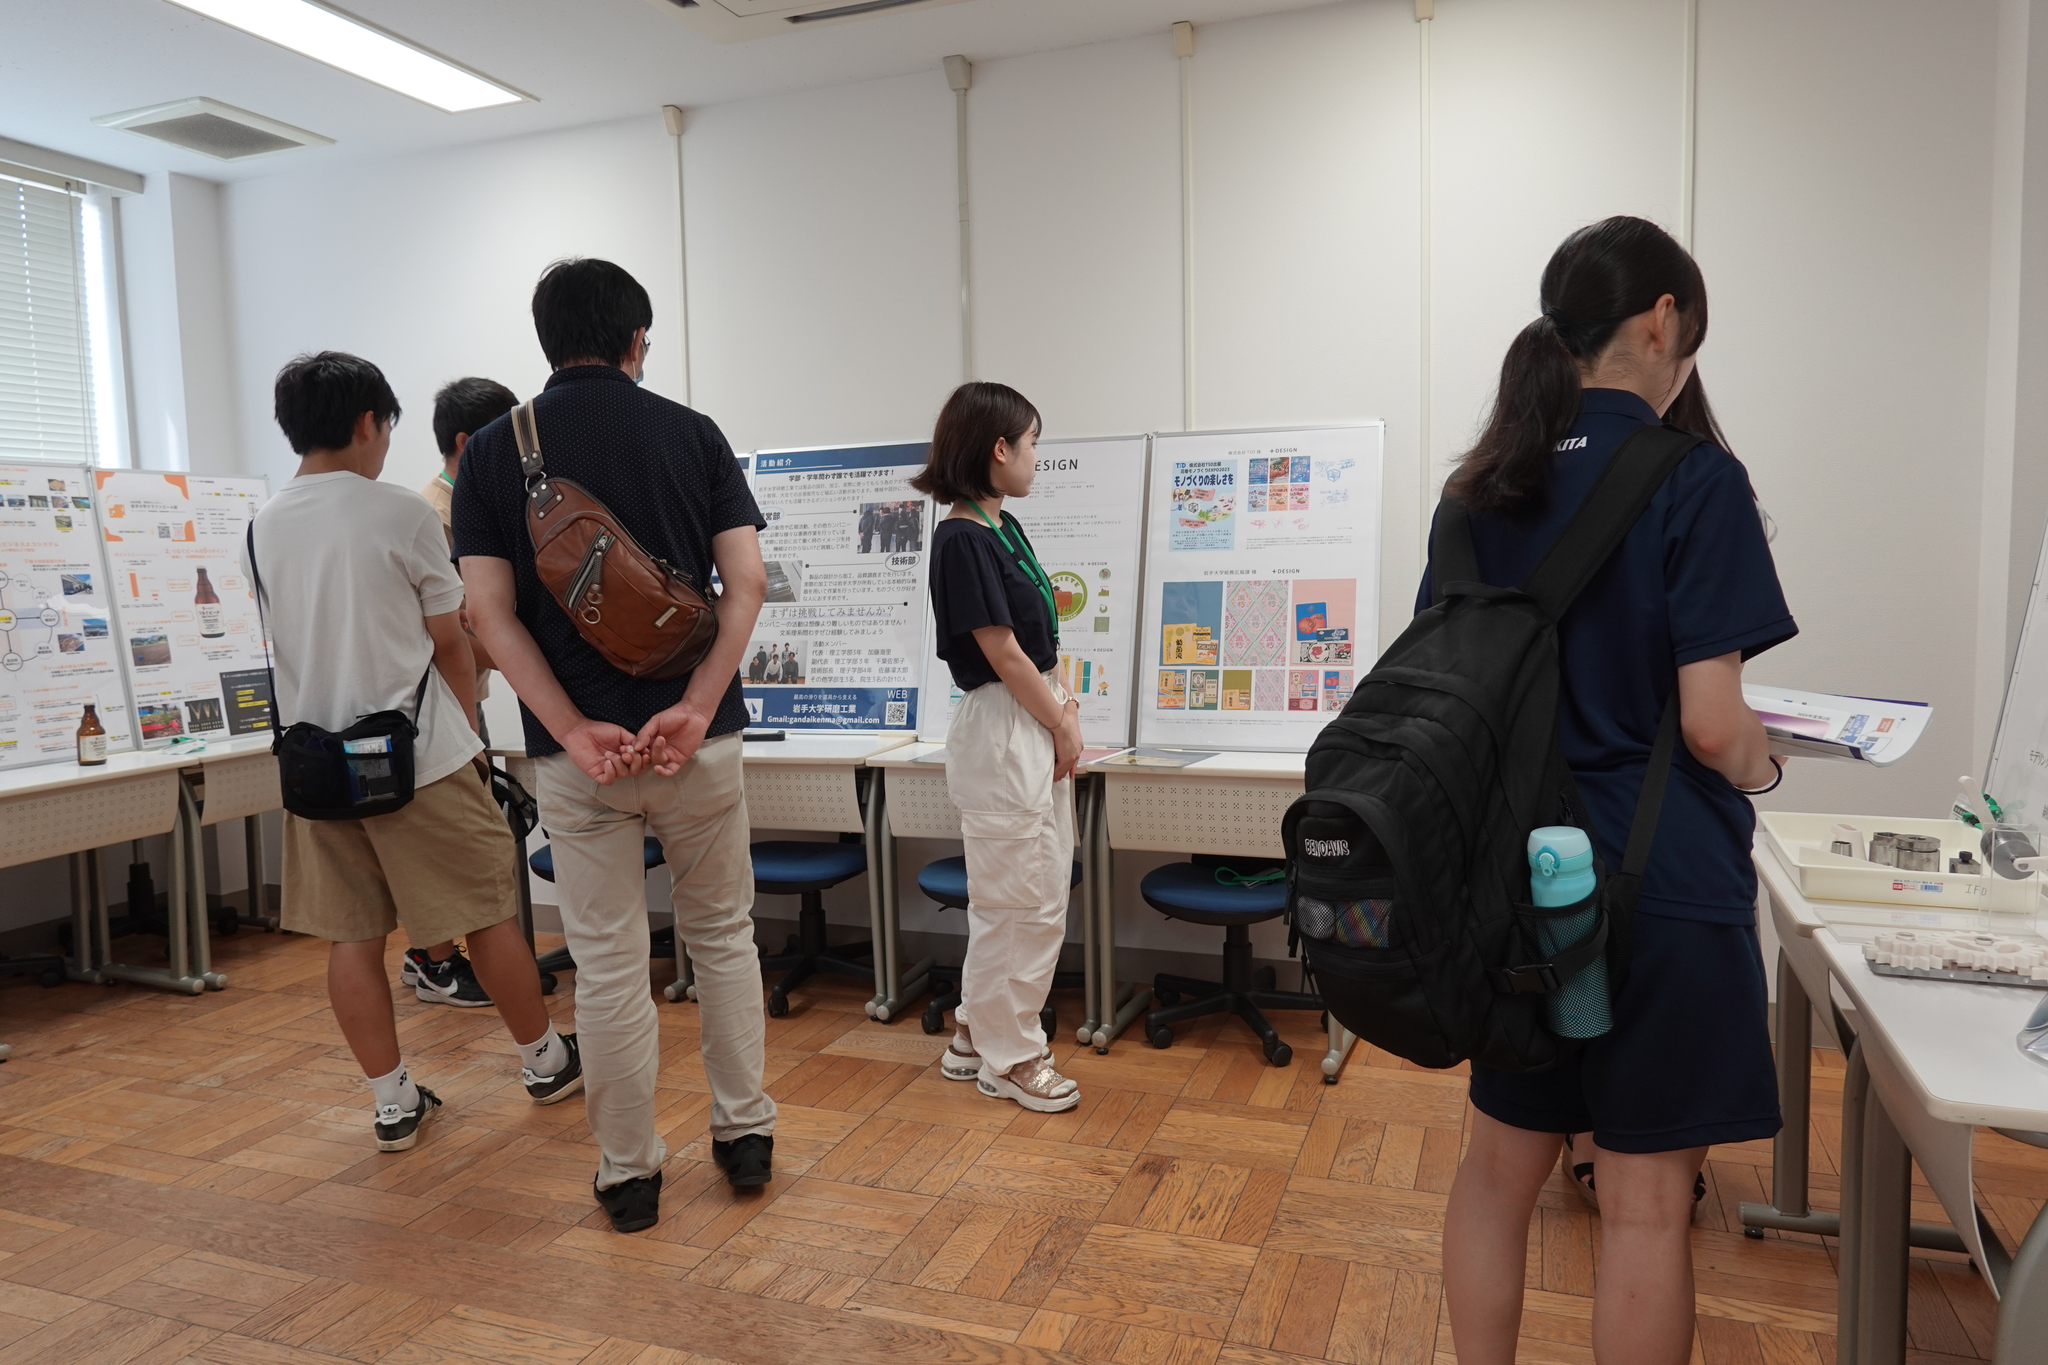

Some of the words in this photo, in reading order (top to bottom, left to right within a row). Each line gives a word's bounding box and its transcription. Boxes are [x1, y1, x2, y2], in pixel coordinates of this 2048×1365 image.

[760, 458, 792, 467] 活動紹介
[1034, 459, 1078, 471] ESIGN
[1174, 473, 1234, 487] モノづくりの楽しさを
[891, 555, 917, 566] 技術部
[770, 606, 894, 619] まずは挑戦してみませんか？
[887, 690, 908, 699] WEB
[793, 703, 857, 714] 岩手大学研磨工業
[767, 715, 880, 725] Gmail:gandaikenma@gmail.com
